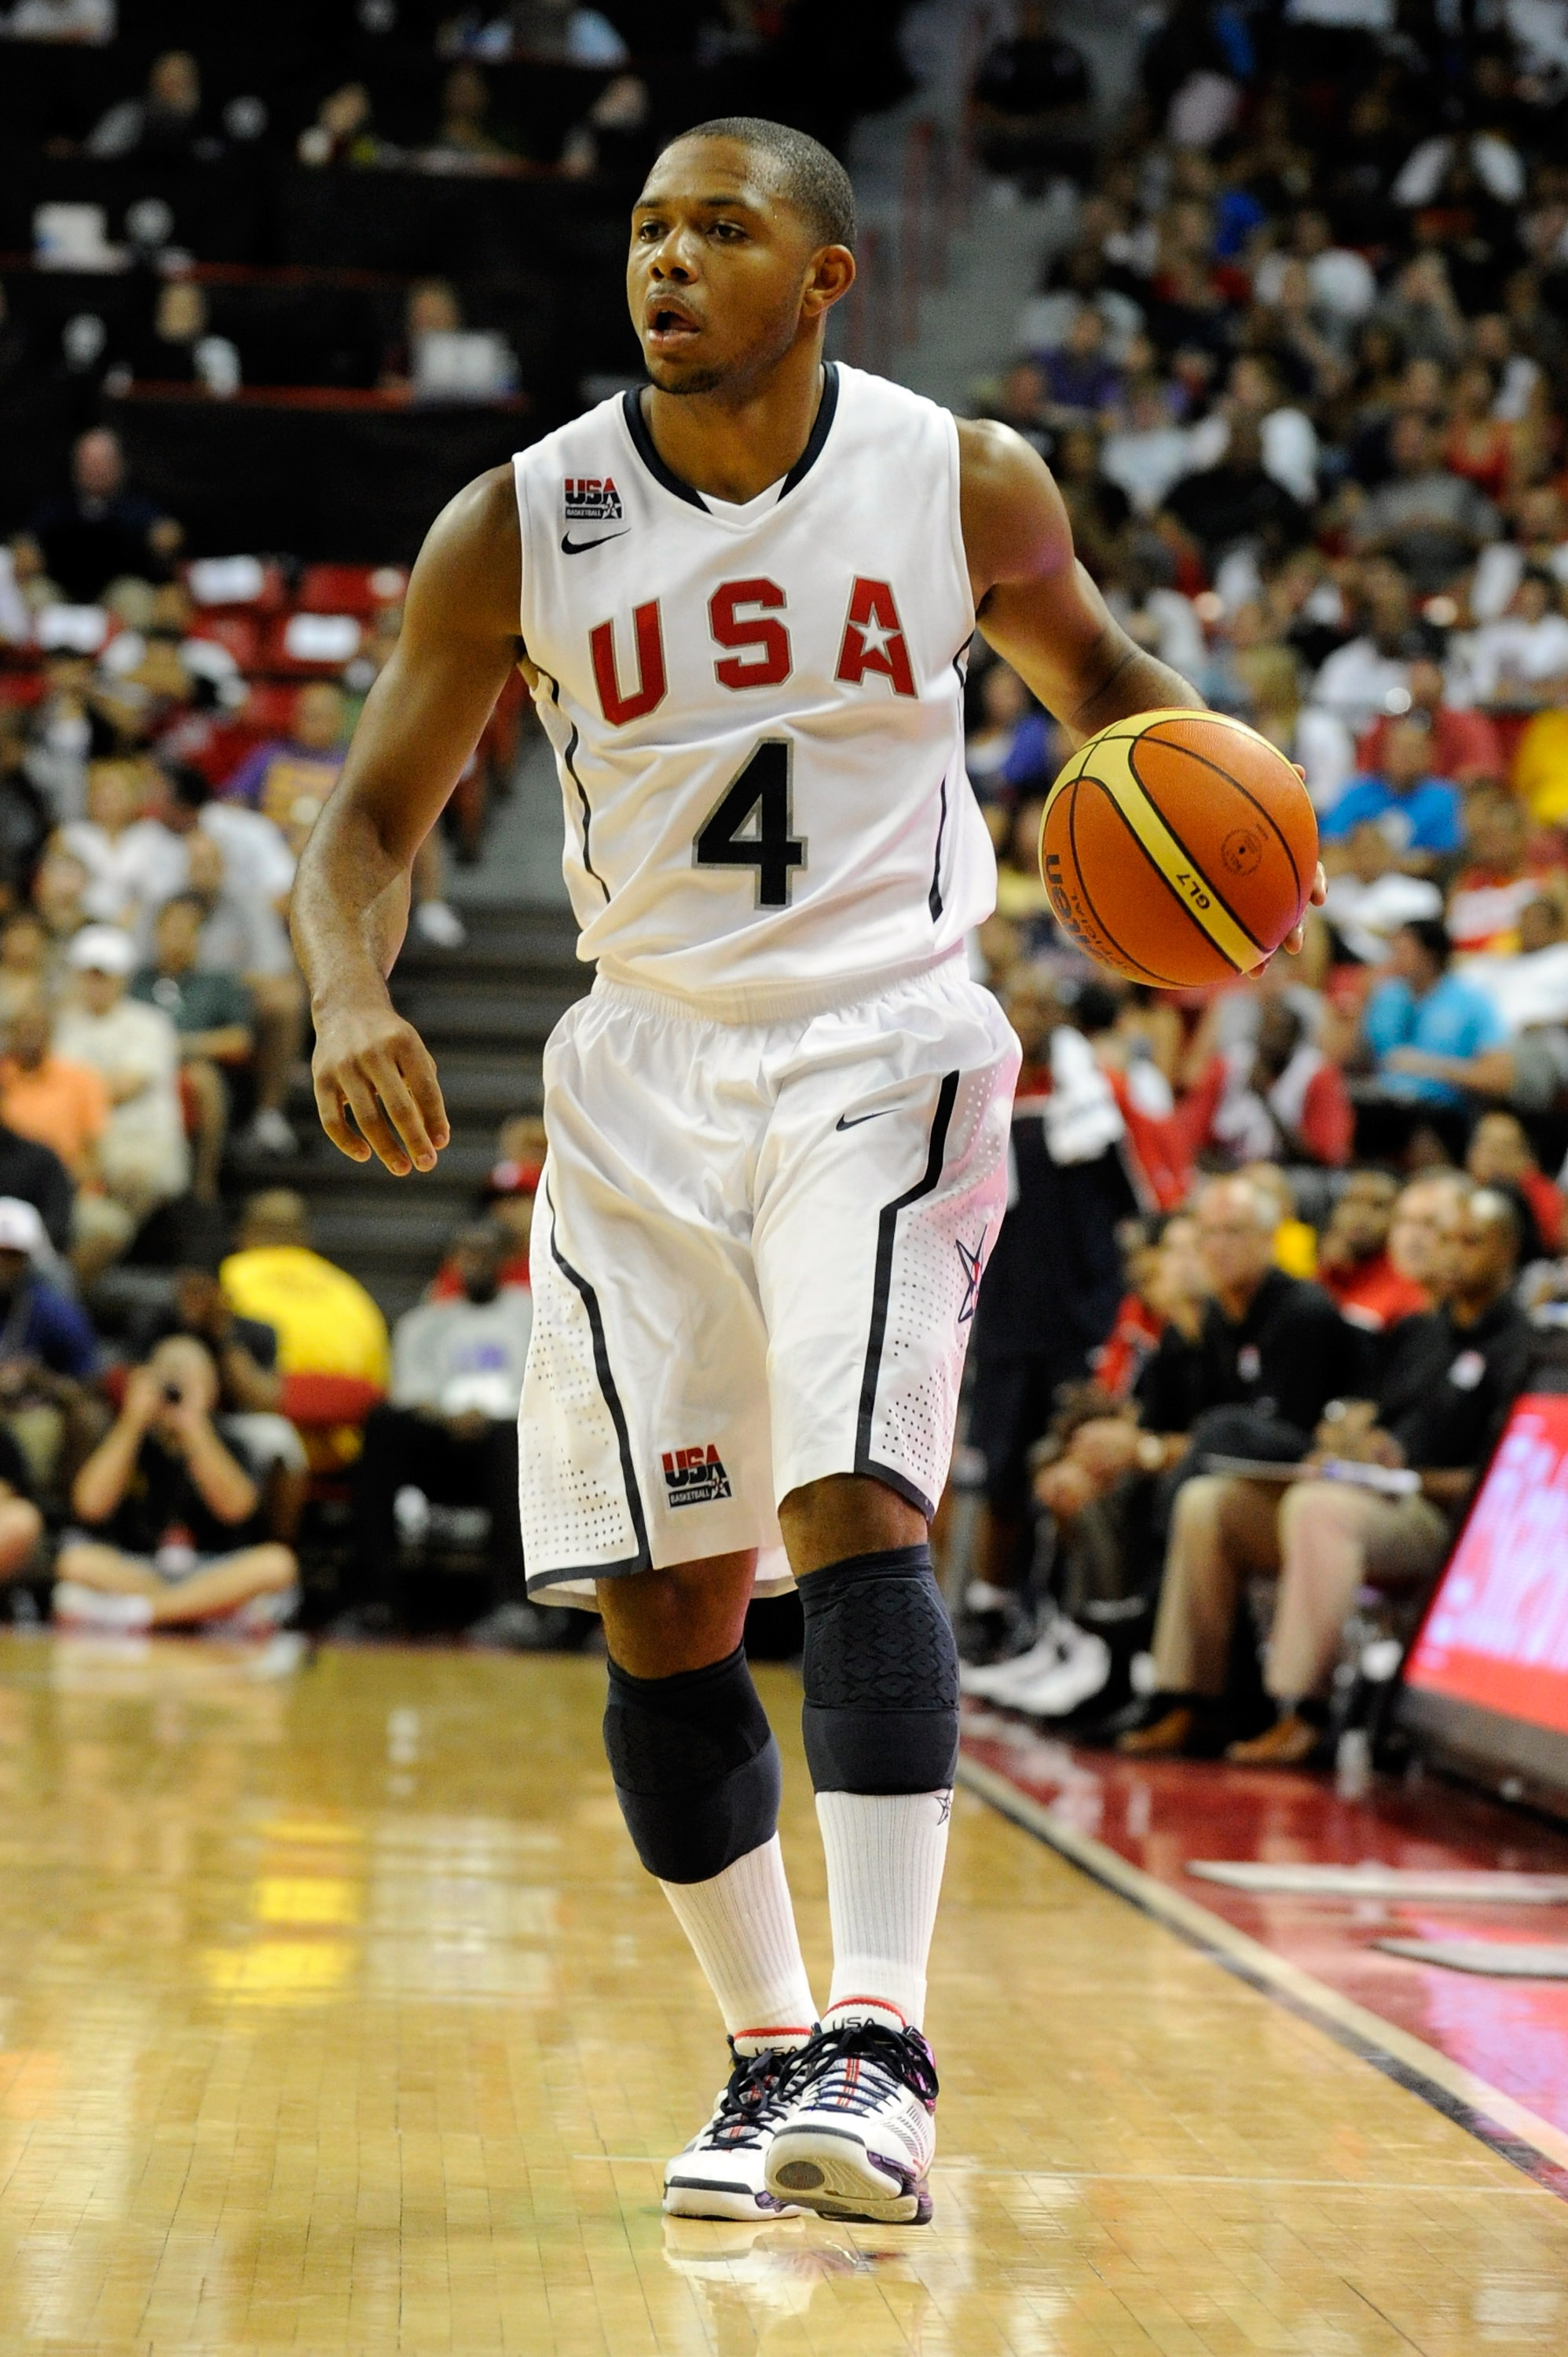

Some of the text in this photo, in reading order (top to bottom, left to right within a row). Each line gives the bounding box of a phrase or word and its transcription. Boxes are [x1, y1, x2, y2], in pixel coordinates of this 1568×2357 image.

[565, 477, 621, 504] USA
[566, 508, 602, 517] BASKETBALL
[588, 574, 918, 728] USA
[691, 737, 808, 911] 4
[1175, 874, 1211, 910] GL7
[661, 1443, 727, 1487] USA
[670, 1487, 710, 1505] BASKETBALL
[833, 2016, 876, 2031] USA
